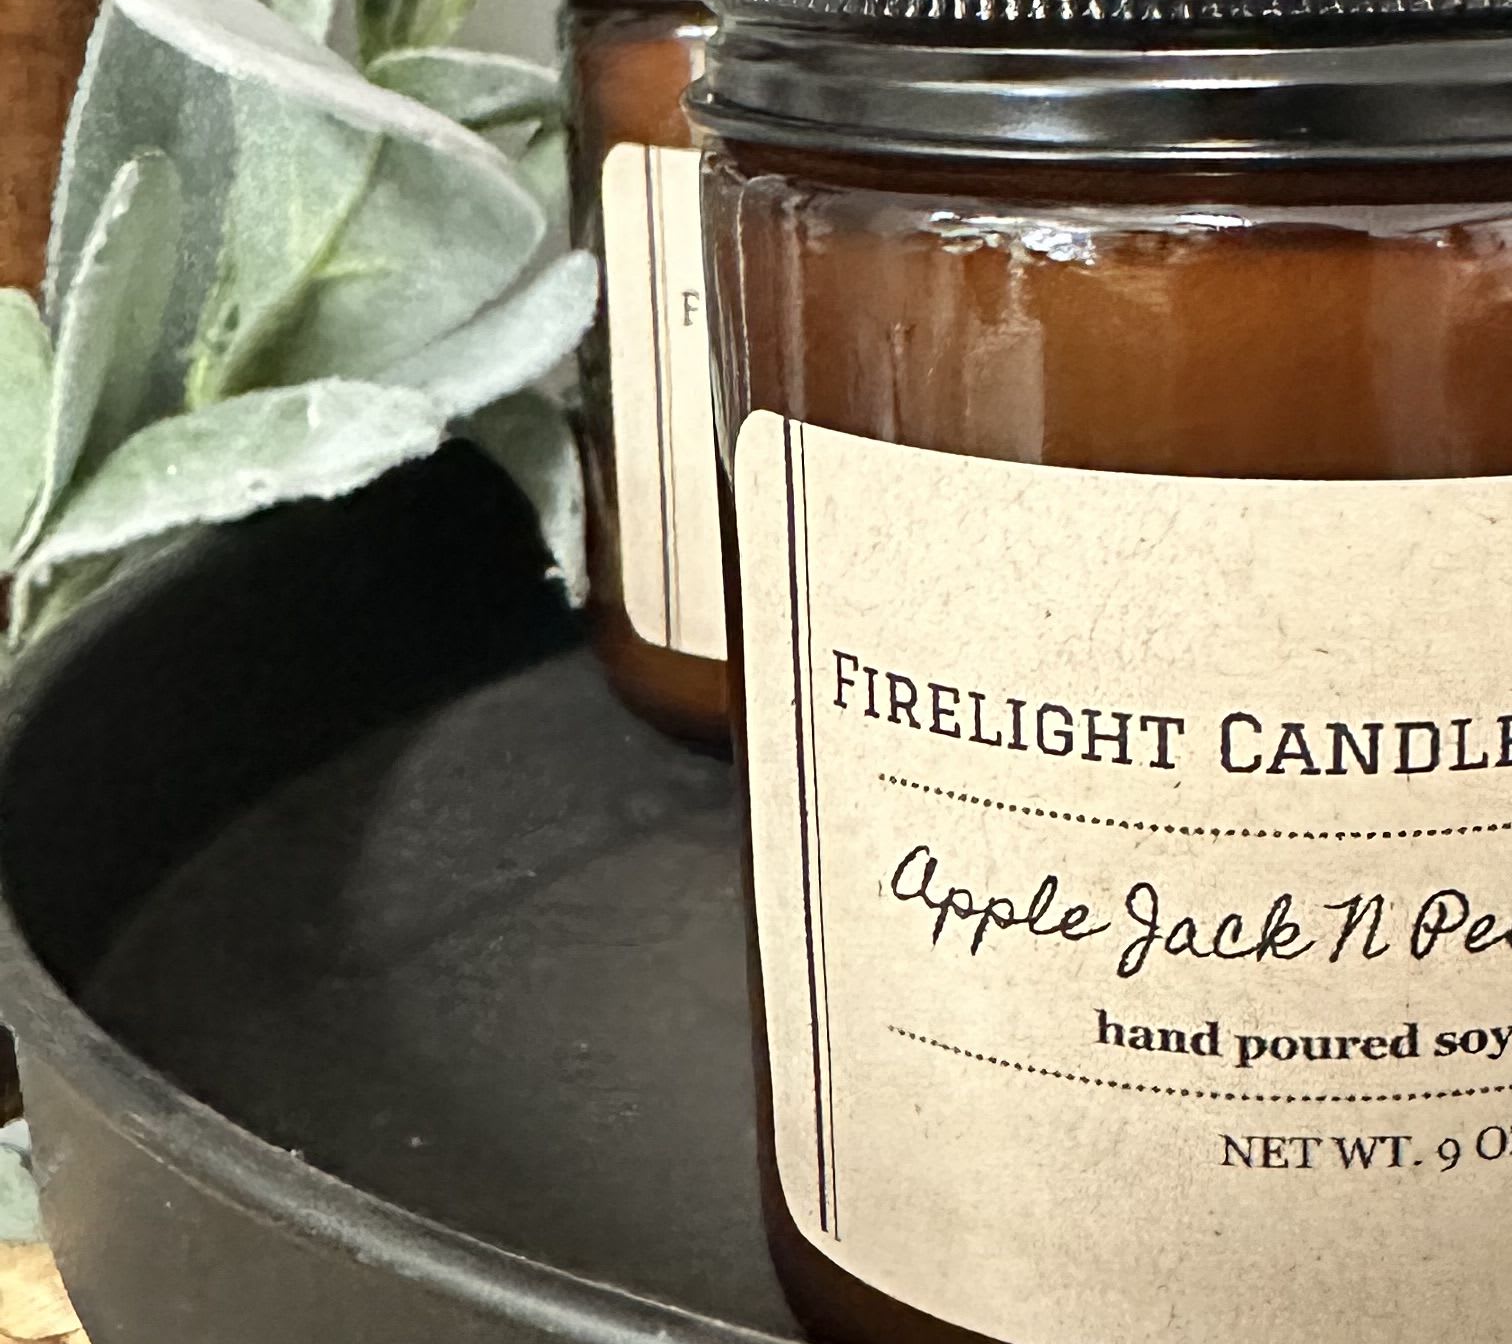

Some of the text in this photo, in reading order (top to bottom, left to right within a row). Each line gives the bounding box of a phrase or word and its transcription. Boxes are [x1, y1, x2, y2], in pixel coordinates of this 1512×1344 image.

[831, 649, 1185, 770] FIRELIGHT
[889, 845, 1112, 956] Apple
[1115, 882, 1316, 979] Jack
[1323, 893, 1393, 963] N
[1093, 1008, 1222, 1059] hand
[1234, 1021, 1421, 1069] poured
[1218, 1133, 1324, 1170] NET
[1330, 1133, 1424, 1170] WT.
[1435, 1137, 1462, 1173] 9
